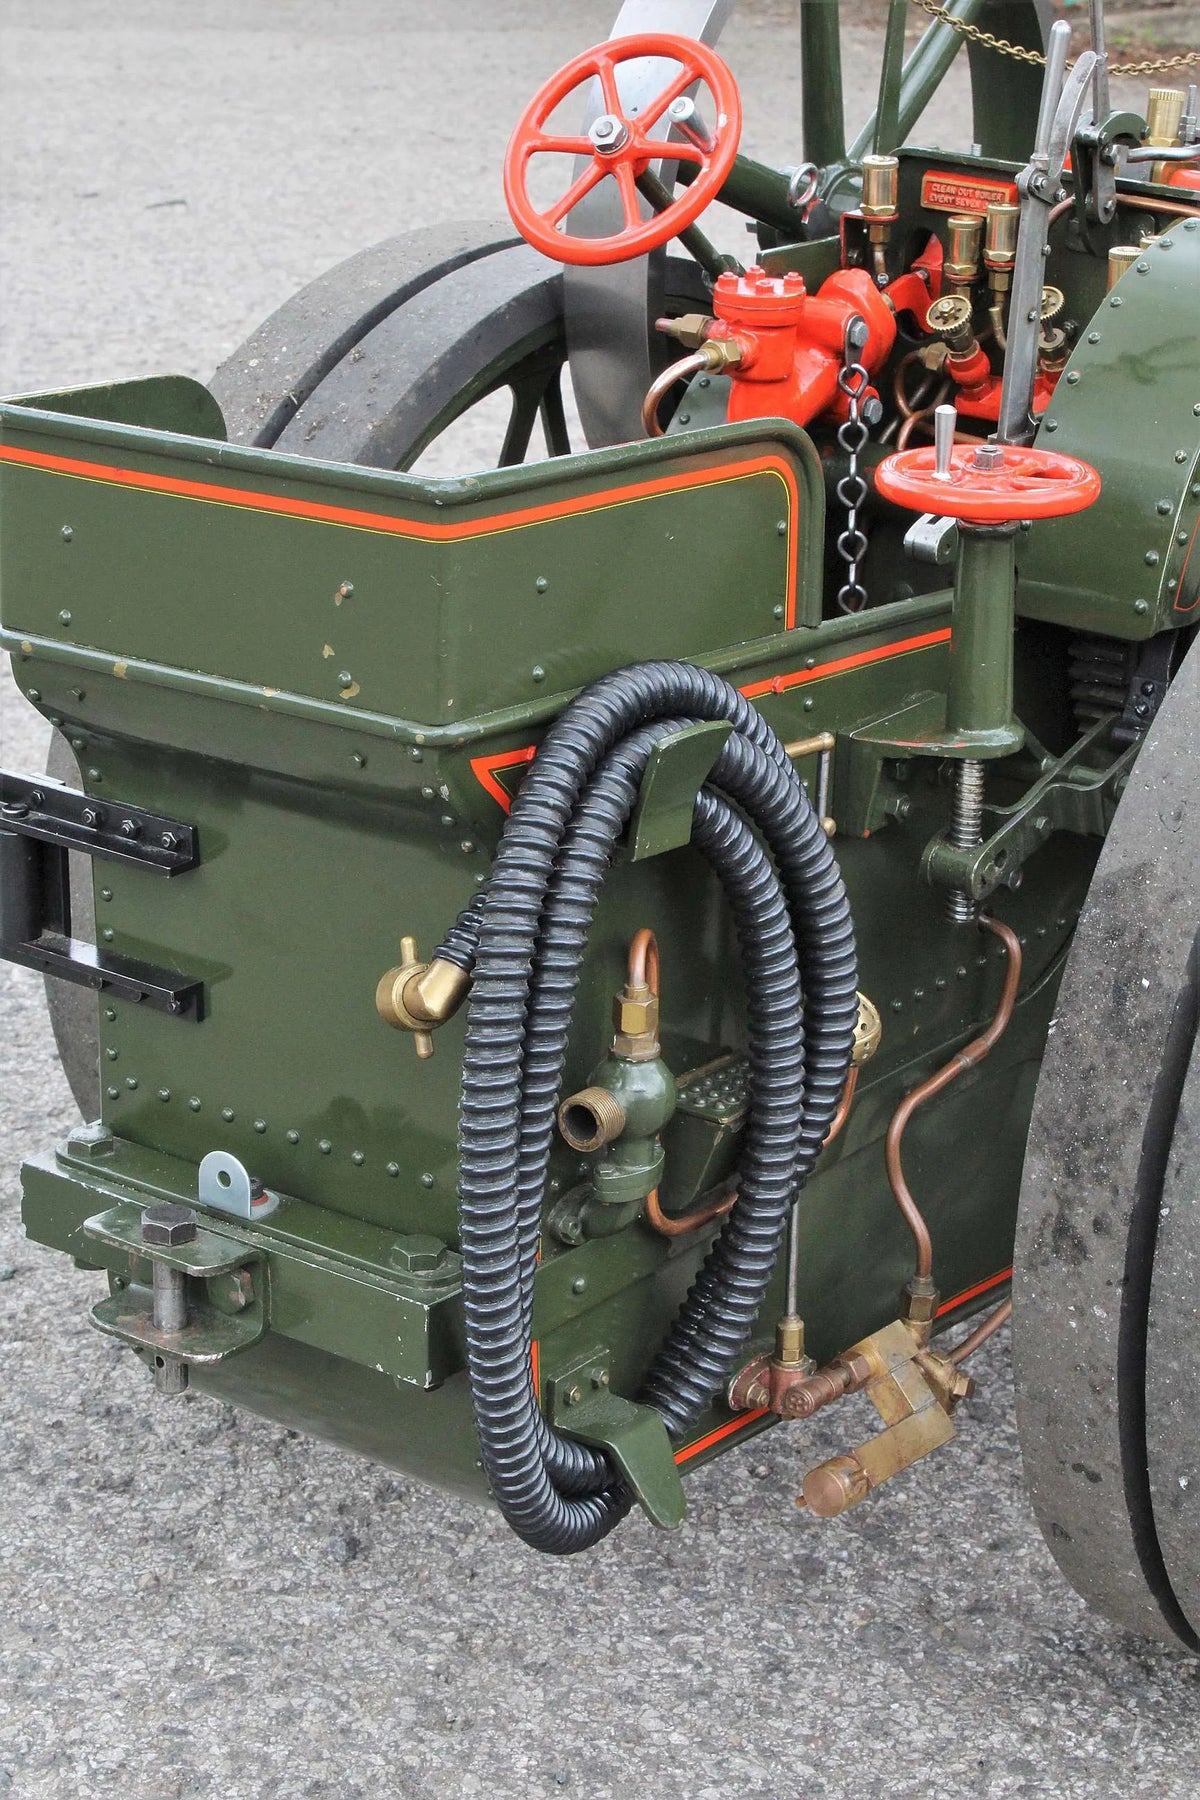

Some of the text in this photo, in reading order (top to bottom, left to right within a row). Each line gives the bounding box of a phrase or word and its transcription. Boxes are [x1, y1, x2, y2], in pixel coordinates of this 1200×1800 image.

[931, 183, 1004, 201] CLEAN OUT BOILER
[929, 193, 955, 204] EVERY
[956, 197, 981, 209] SEVEN
